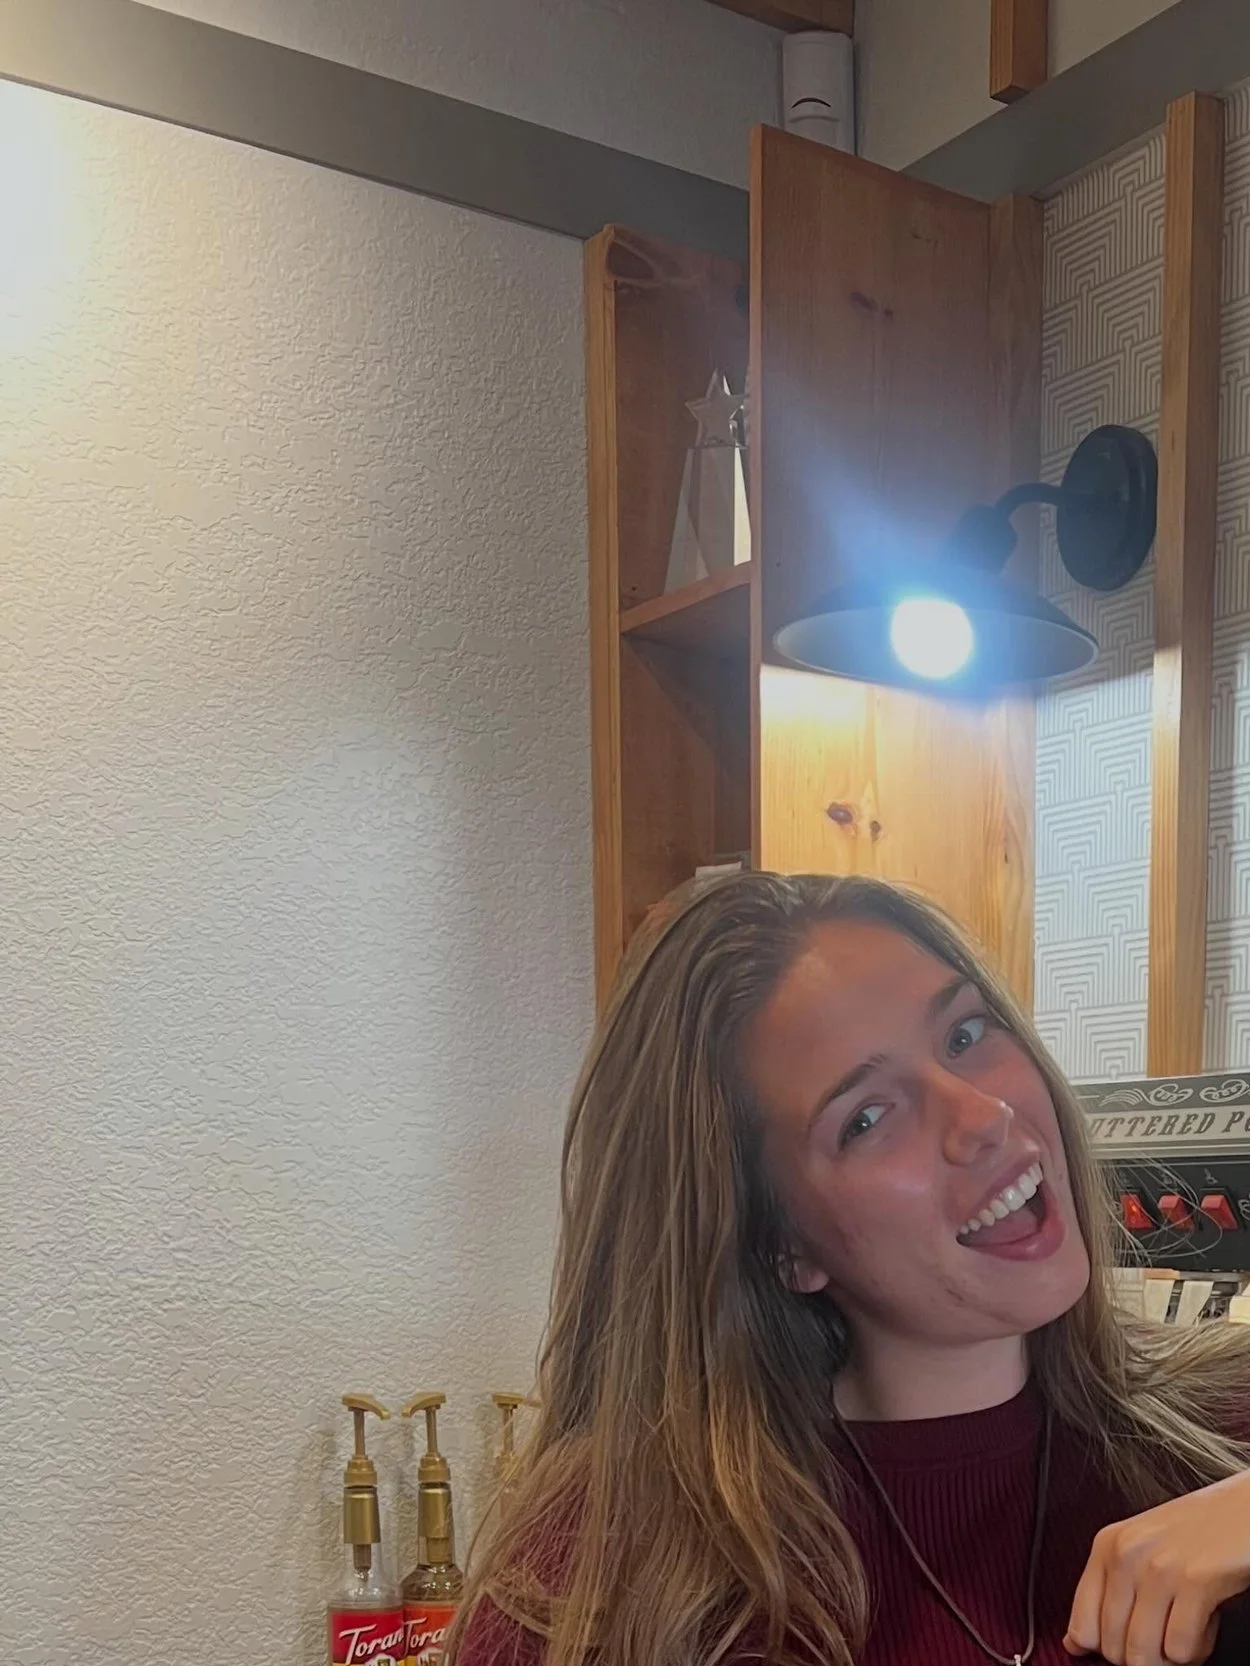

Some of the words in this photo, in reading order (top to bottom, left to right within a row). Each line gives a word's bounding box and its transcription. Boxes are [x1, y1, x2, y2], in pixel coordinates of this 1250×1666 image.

[1087, 1112, 1216, 1139] UTTERED
[339, 1623, 405, 1666] Toran
[403, 1616, 446, 1656] Tora
